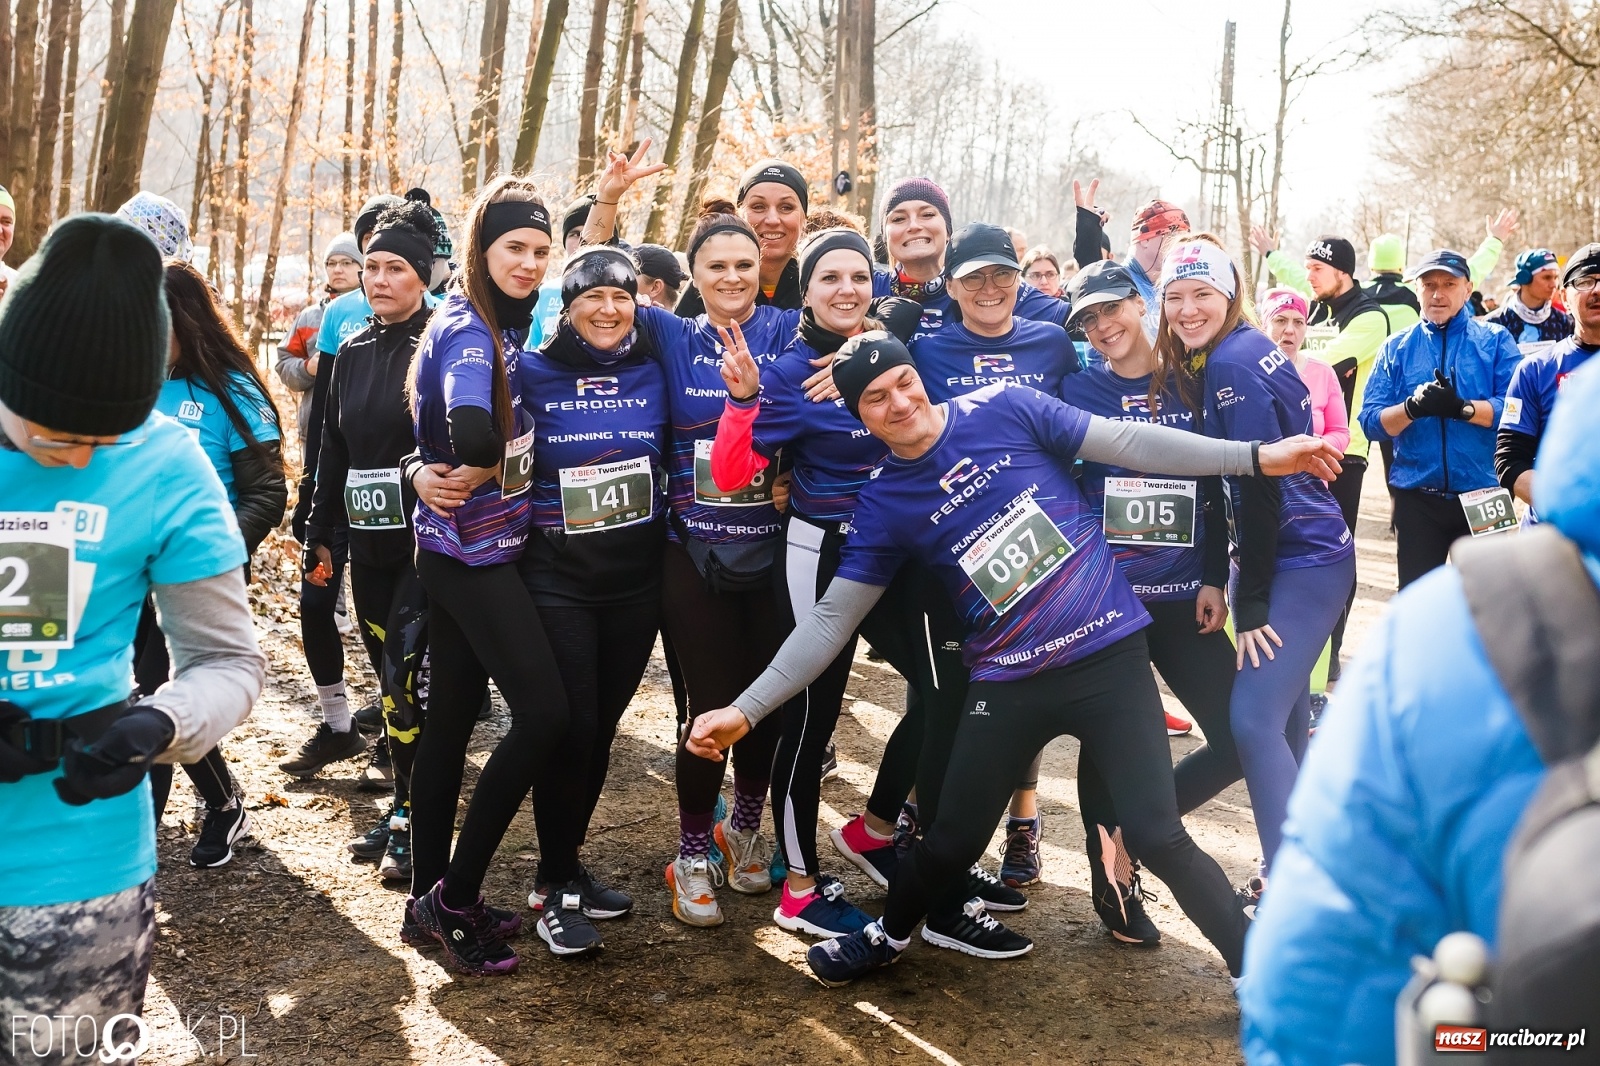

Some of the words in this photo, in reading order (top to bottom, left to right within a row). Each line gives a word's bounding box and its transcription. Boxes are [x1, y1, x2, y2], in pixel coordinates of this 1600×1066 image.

[545, 398, 647, 413] FEROCITY
[547, 431, 614, 444] RUNNING
[618, 430, 656, 440] TEAM
[570, 470, 576, 478] X
[577, 468, 597, 477] BIEG
[597, 461, 641, 475] Twardziela
[587, 482, 630, 512] 141
[929, 453, 1012, 526] FEROCITY
[1115, 479, 1122, 487] X
[1123, 480, 1142, 488] BIEG
[1142, 481, 1187, 490] Twardziela
[351, 488, 387, 512] 080
[1125, 499, 1176, 526] 015
[1476, 499, 1506, 522] 159
[950, 511, 1003, 555] RUNNING
[1003, 482, 1040, 516] TEAM
[985, 507, 1026, 543] Twardziela
[987, 527, 1040, 584] 087
